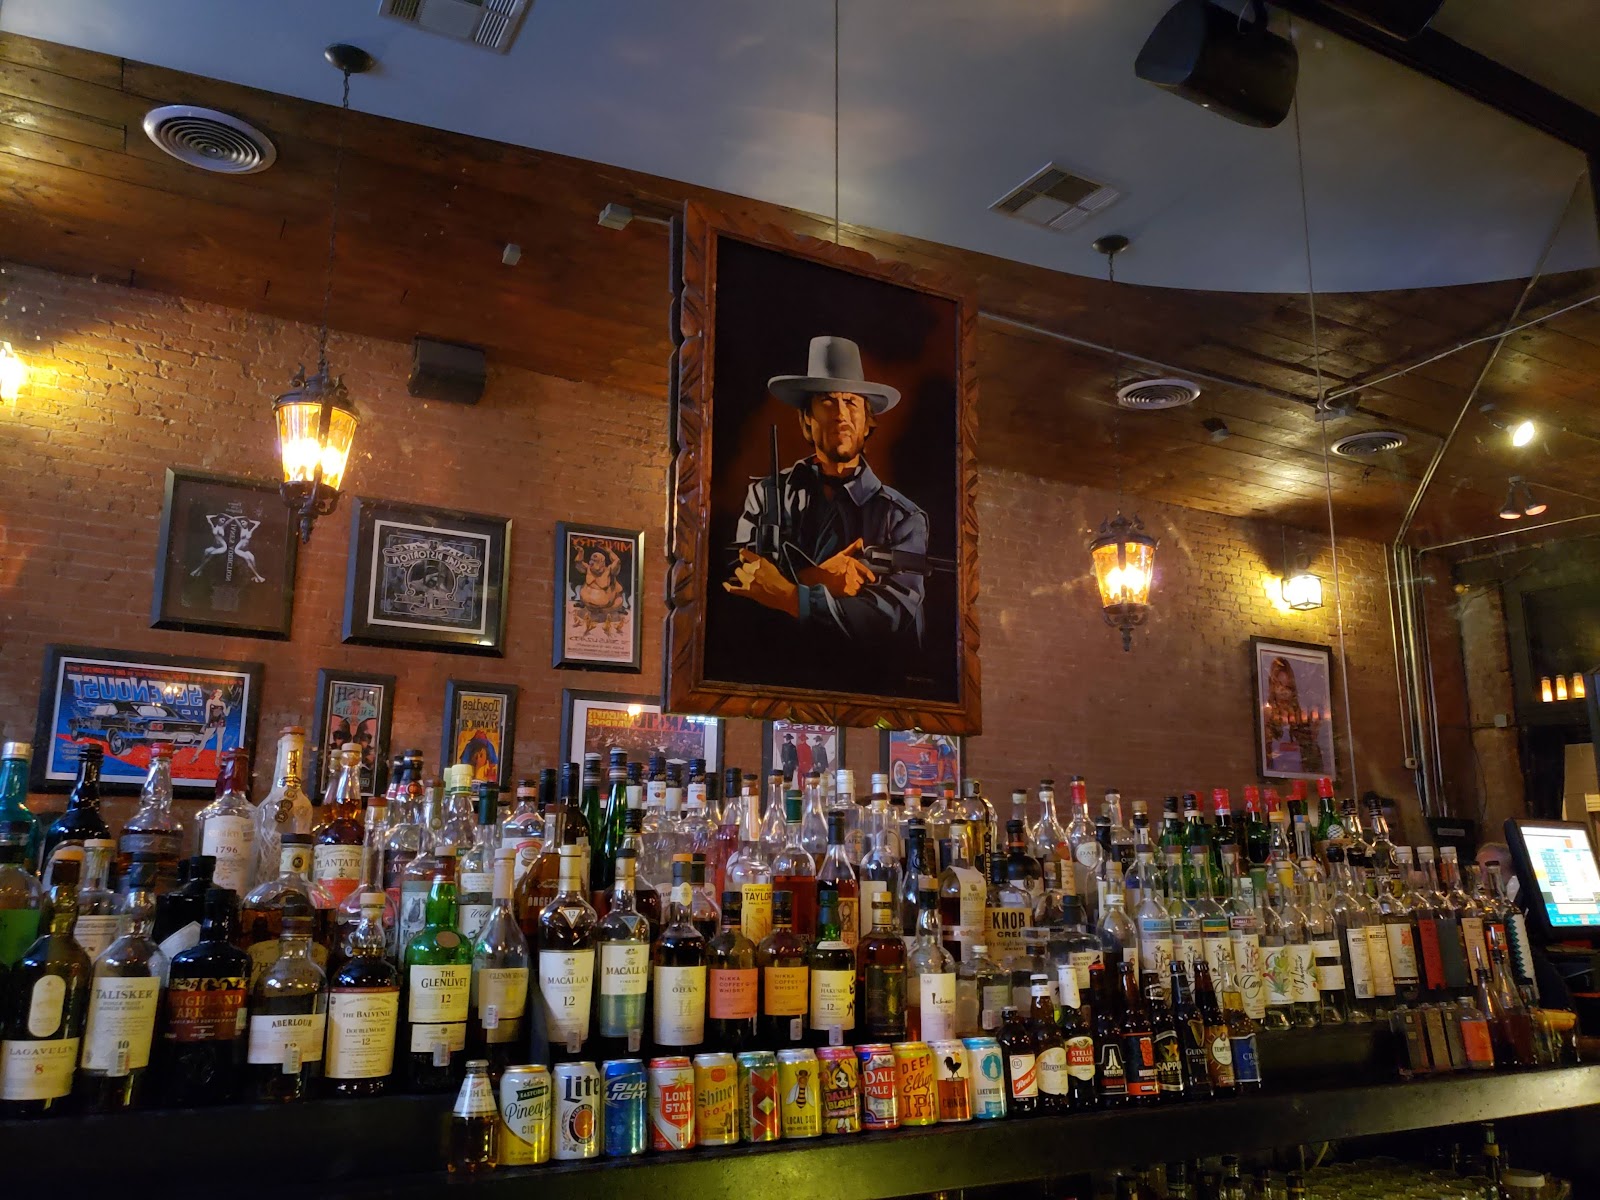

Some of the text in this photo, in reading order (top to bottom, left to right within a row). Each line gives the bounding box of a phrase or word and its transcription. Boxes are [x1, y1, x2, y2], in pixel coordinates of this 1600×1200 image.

[215, 846, 238, 854] 1796
[992, 911, 1026, 930] KNOB
[440, 970, 455, 978] THE
[421, 978, 467, 988] GLENLIVET
[547, 976, 590, 984] MACALLAN
[95, 989, 154, 1000] TALISKER
[672, 986, 698, 994] OBAN
[440, 994, 452, 1003] 12
[562, 995, 576, 1006] 12
[826, 1003, 835, 1011] 12
[356, 1010, 391, 1018] BALVENIE
[271, 1018, 313, 1028] ABERLOUR
[118, 1040, 130, 1049] 10
[901, 1053, 931, 1074] DEEP
[34, 1064, 44, 1074] 8
[563, 1075, 600, 1103] Lite
[612, 1081, 648, 1092] BUD
[864, 1085, 889, 1095] PALE
[605, 1089, 648, 1101] LIGHT
[665, 1090, 691, 1102] LONE
[697, 1084, 737, 1108] Shiner
[665, 1101, 691, 1113] STAR
[903, 1092, 937, 1118] IPA
[704, 1104, 733, 1118] BOCK
[786, 1115, 803, 1125] LOCAL
